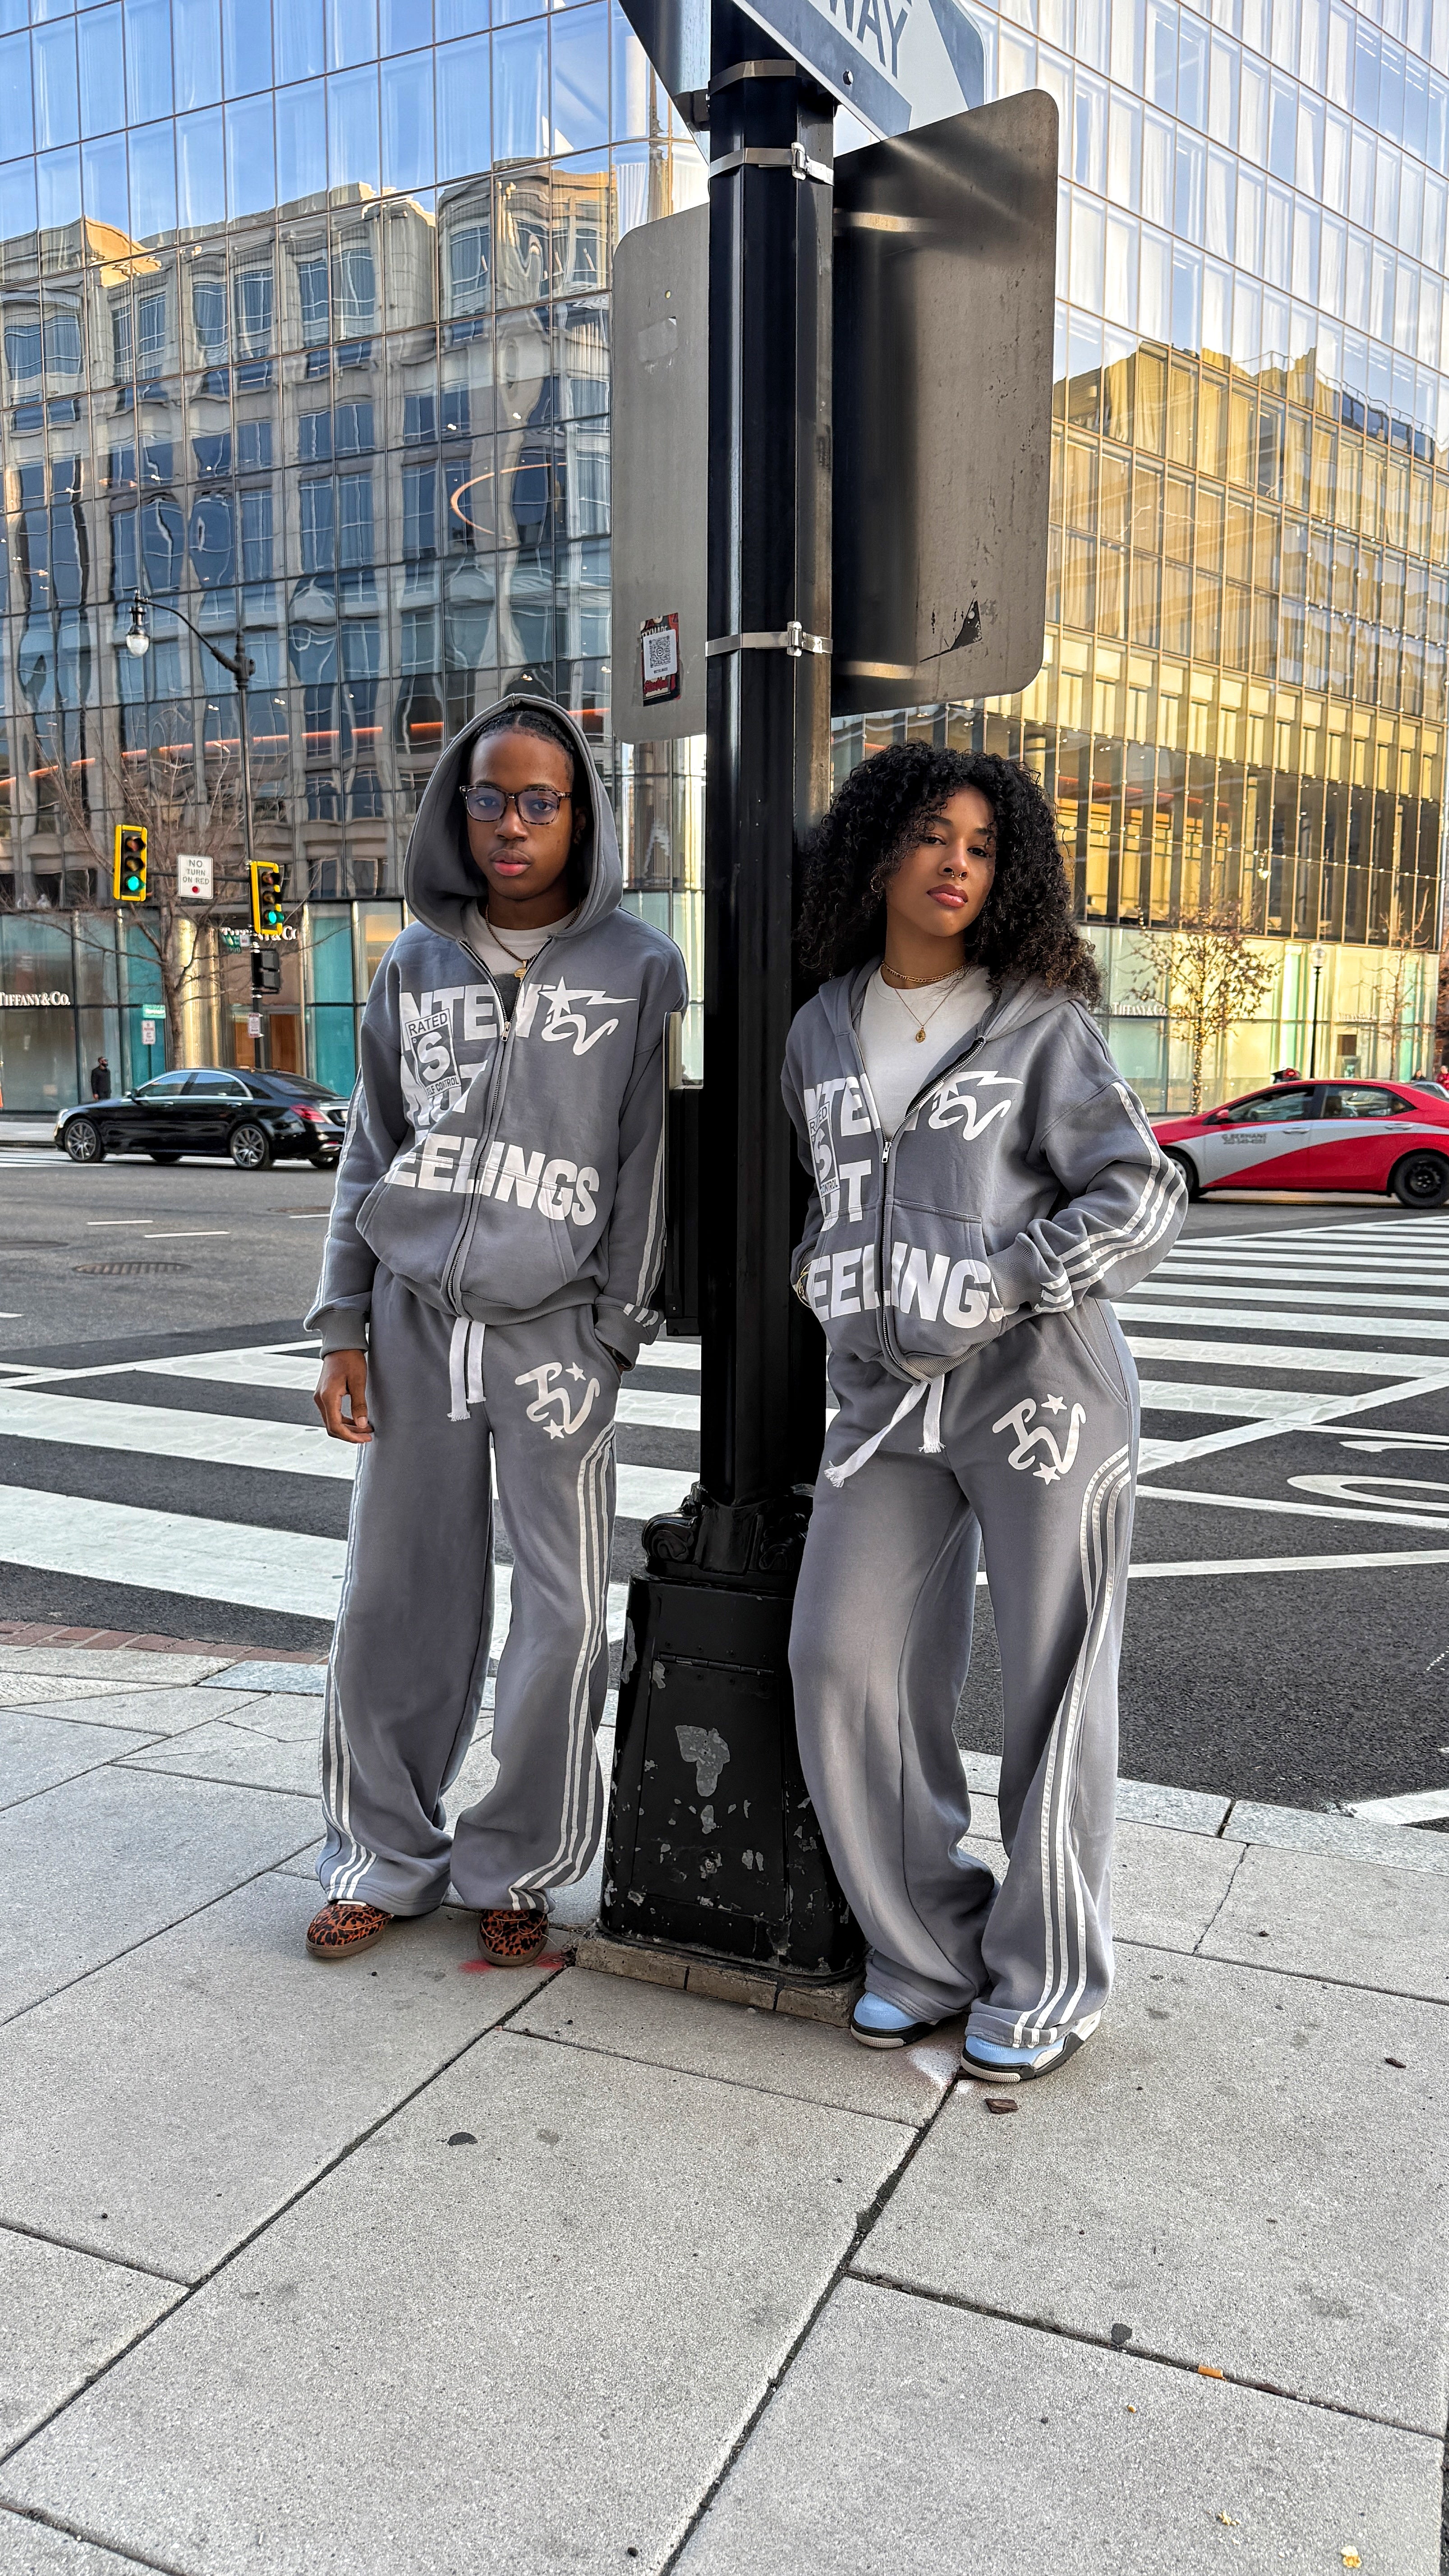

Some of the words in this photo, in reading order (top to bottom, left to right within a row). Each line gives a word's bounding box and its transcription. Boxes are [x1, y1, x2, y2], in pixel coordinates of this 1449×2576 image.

[186, 868, 206, 876] TURN
[189, 859, 203, 868] NO
[408, 1012, 448, 1036] RATED
[417, 1031, 451, 1082] S
[436, 1076, 460, 1092] CONTROL
[806, 1242, 1004, 1329] EELING
